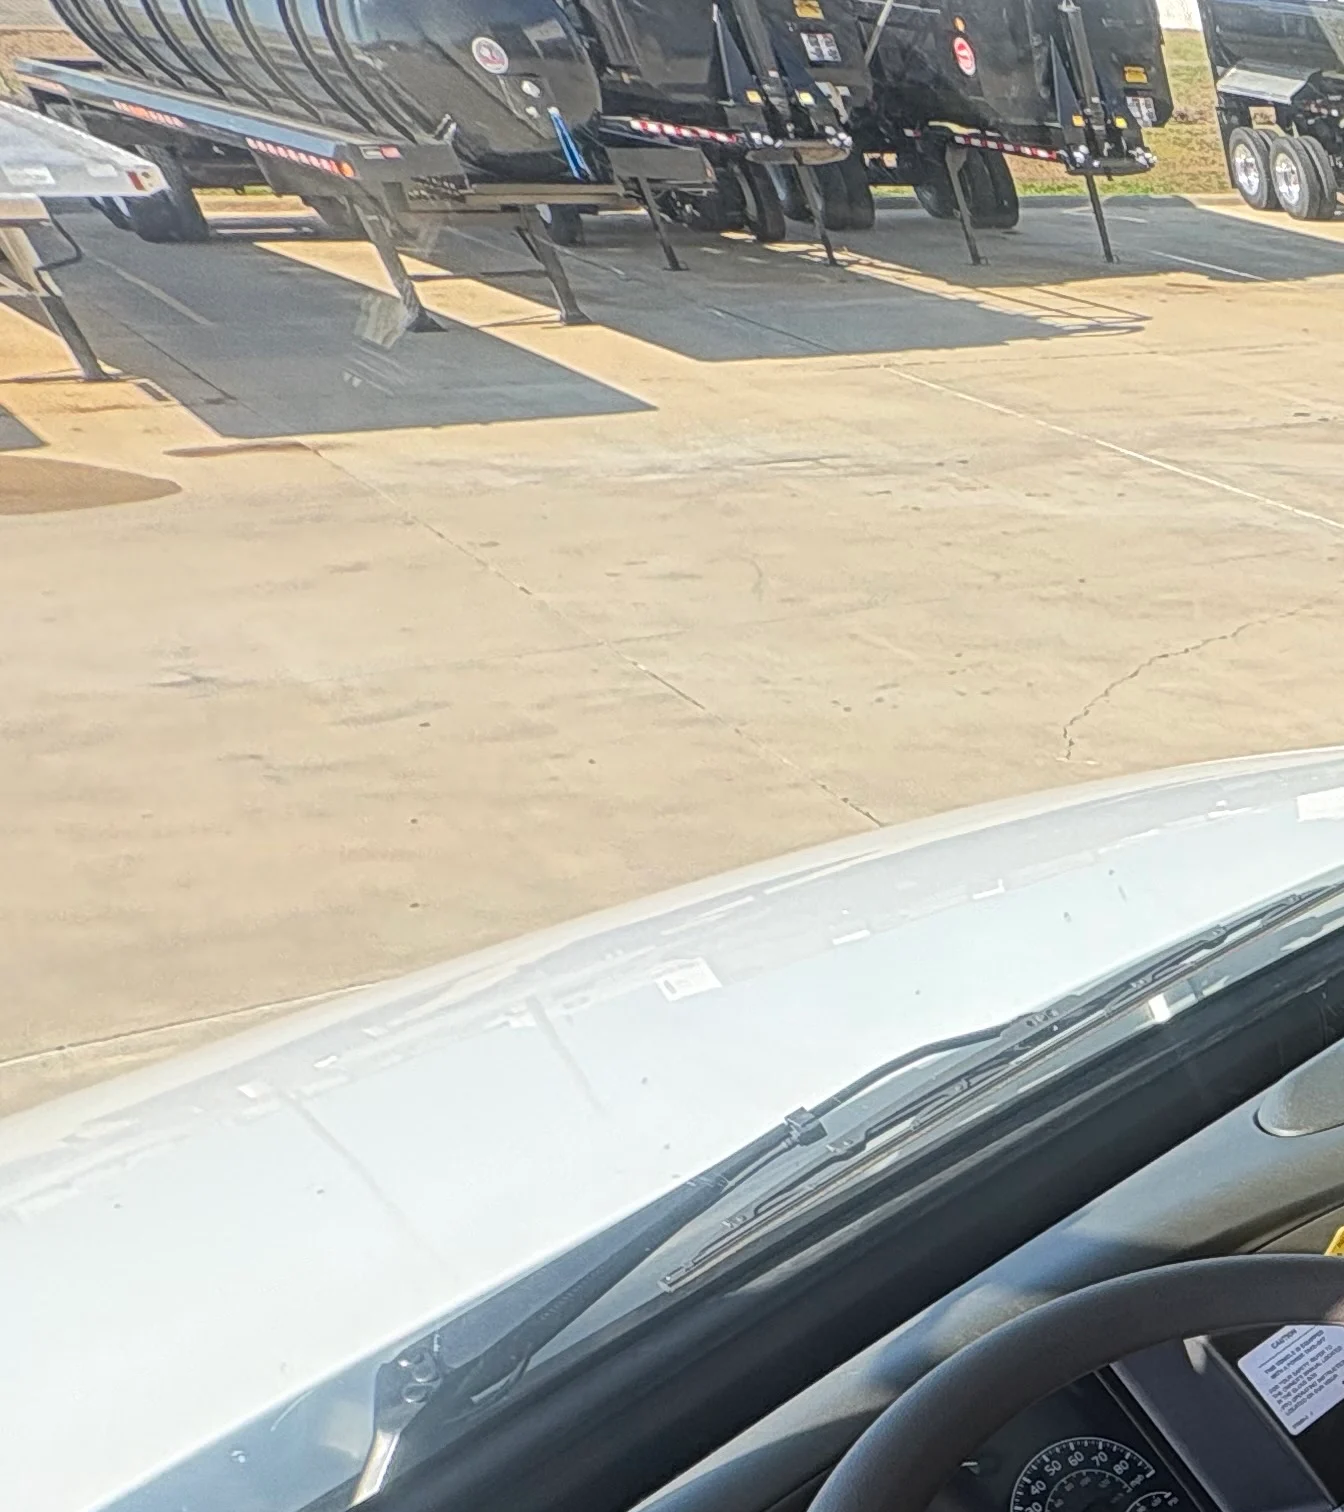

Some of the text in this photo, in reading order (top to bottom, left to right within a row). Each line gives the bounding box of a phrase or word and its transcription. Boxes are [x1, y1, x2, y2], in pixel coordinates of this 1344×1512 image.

[1269, 1327, 1298, 1350] CAUTION
[1067, 1451, 1085, 1467] 60
[1091, 1451, 1108, 1466] 70
[1044, 1460, 1062, 1476] 50
[1113, 1460, 1129, 1475] 80
[1030, 1480, 1047, 1495] 40
